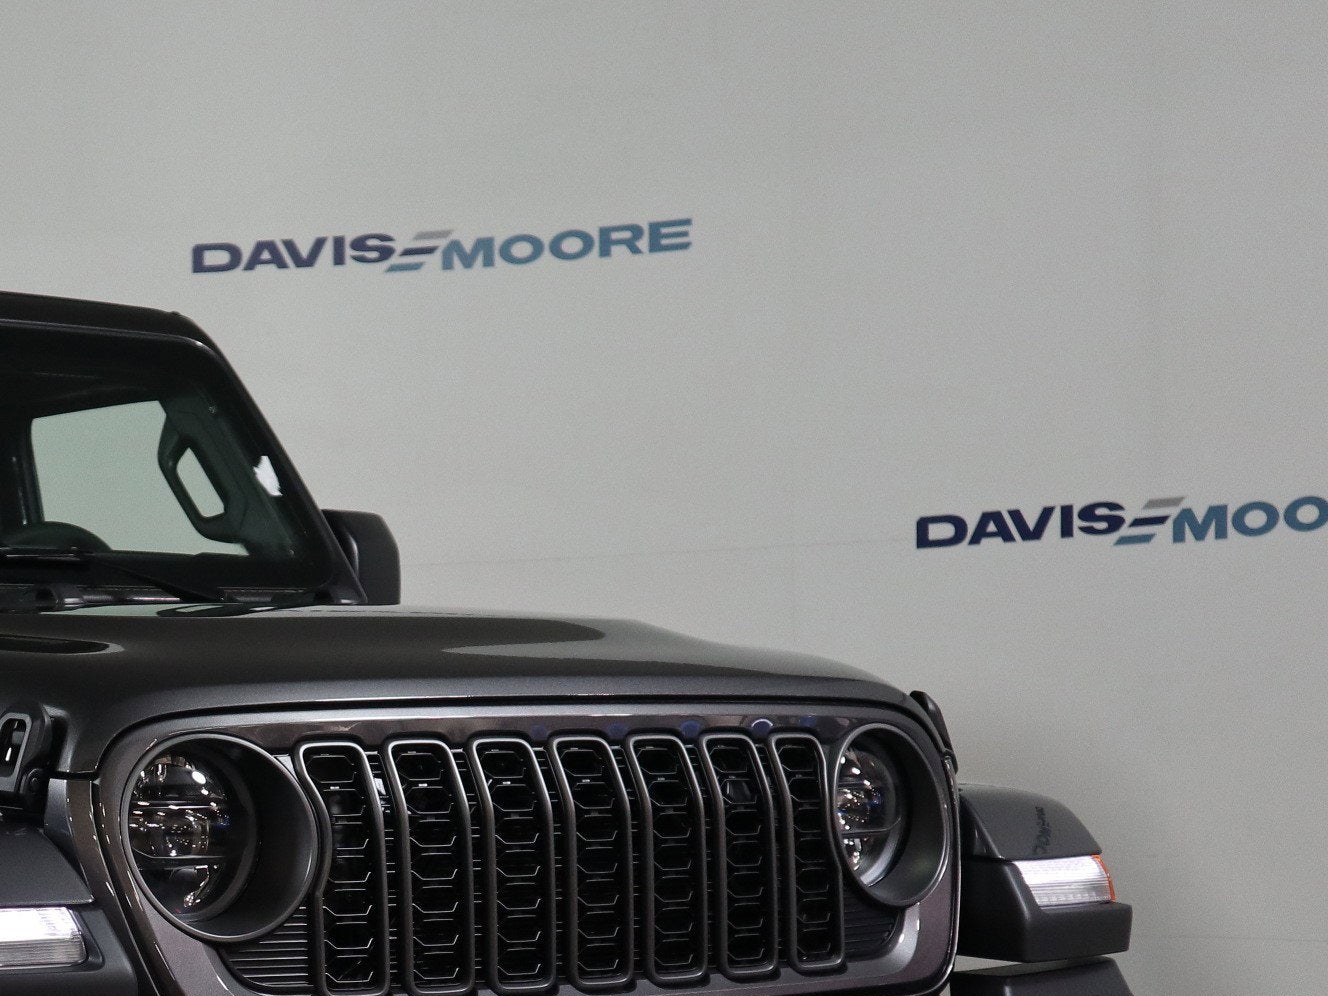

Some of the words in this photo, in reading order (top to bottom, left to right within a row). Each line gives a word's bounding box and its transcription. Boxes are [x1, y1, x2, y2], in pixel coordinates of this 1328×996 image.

[191, 232, 396, 273] DAVIS
[440, 218, 693, 271] MOORE
[916, 501, 1126, 550] DAVIS
